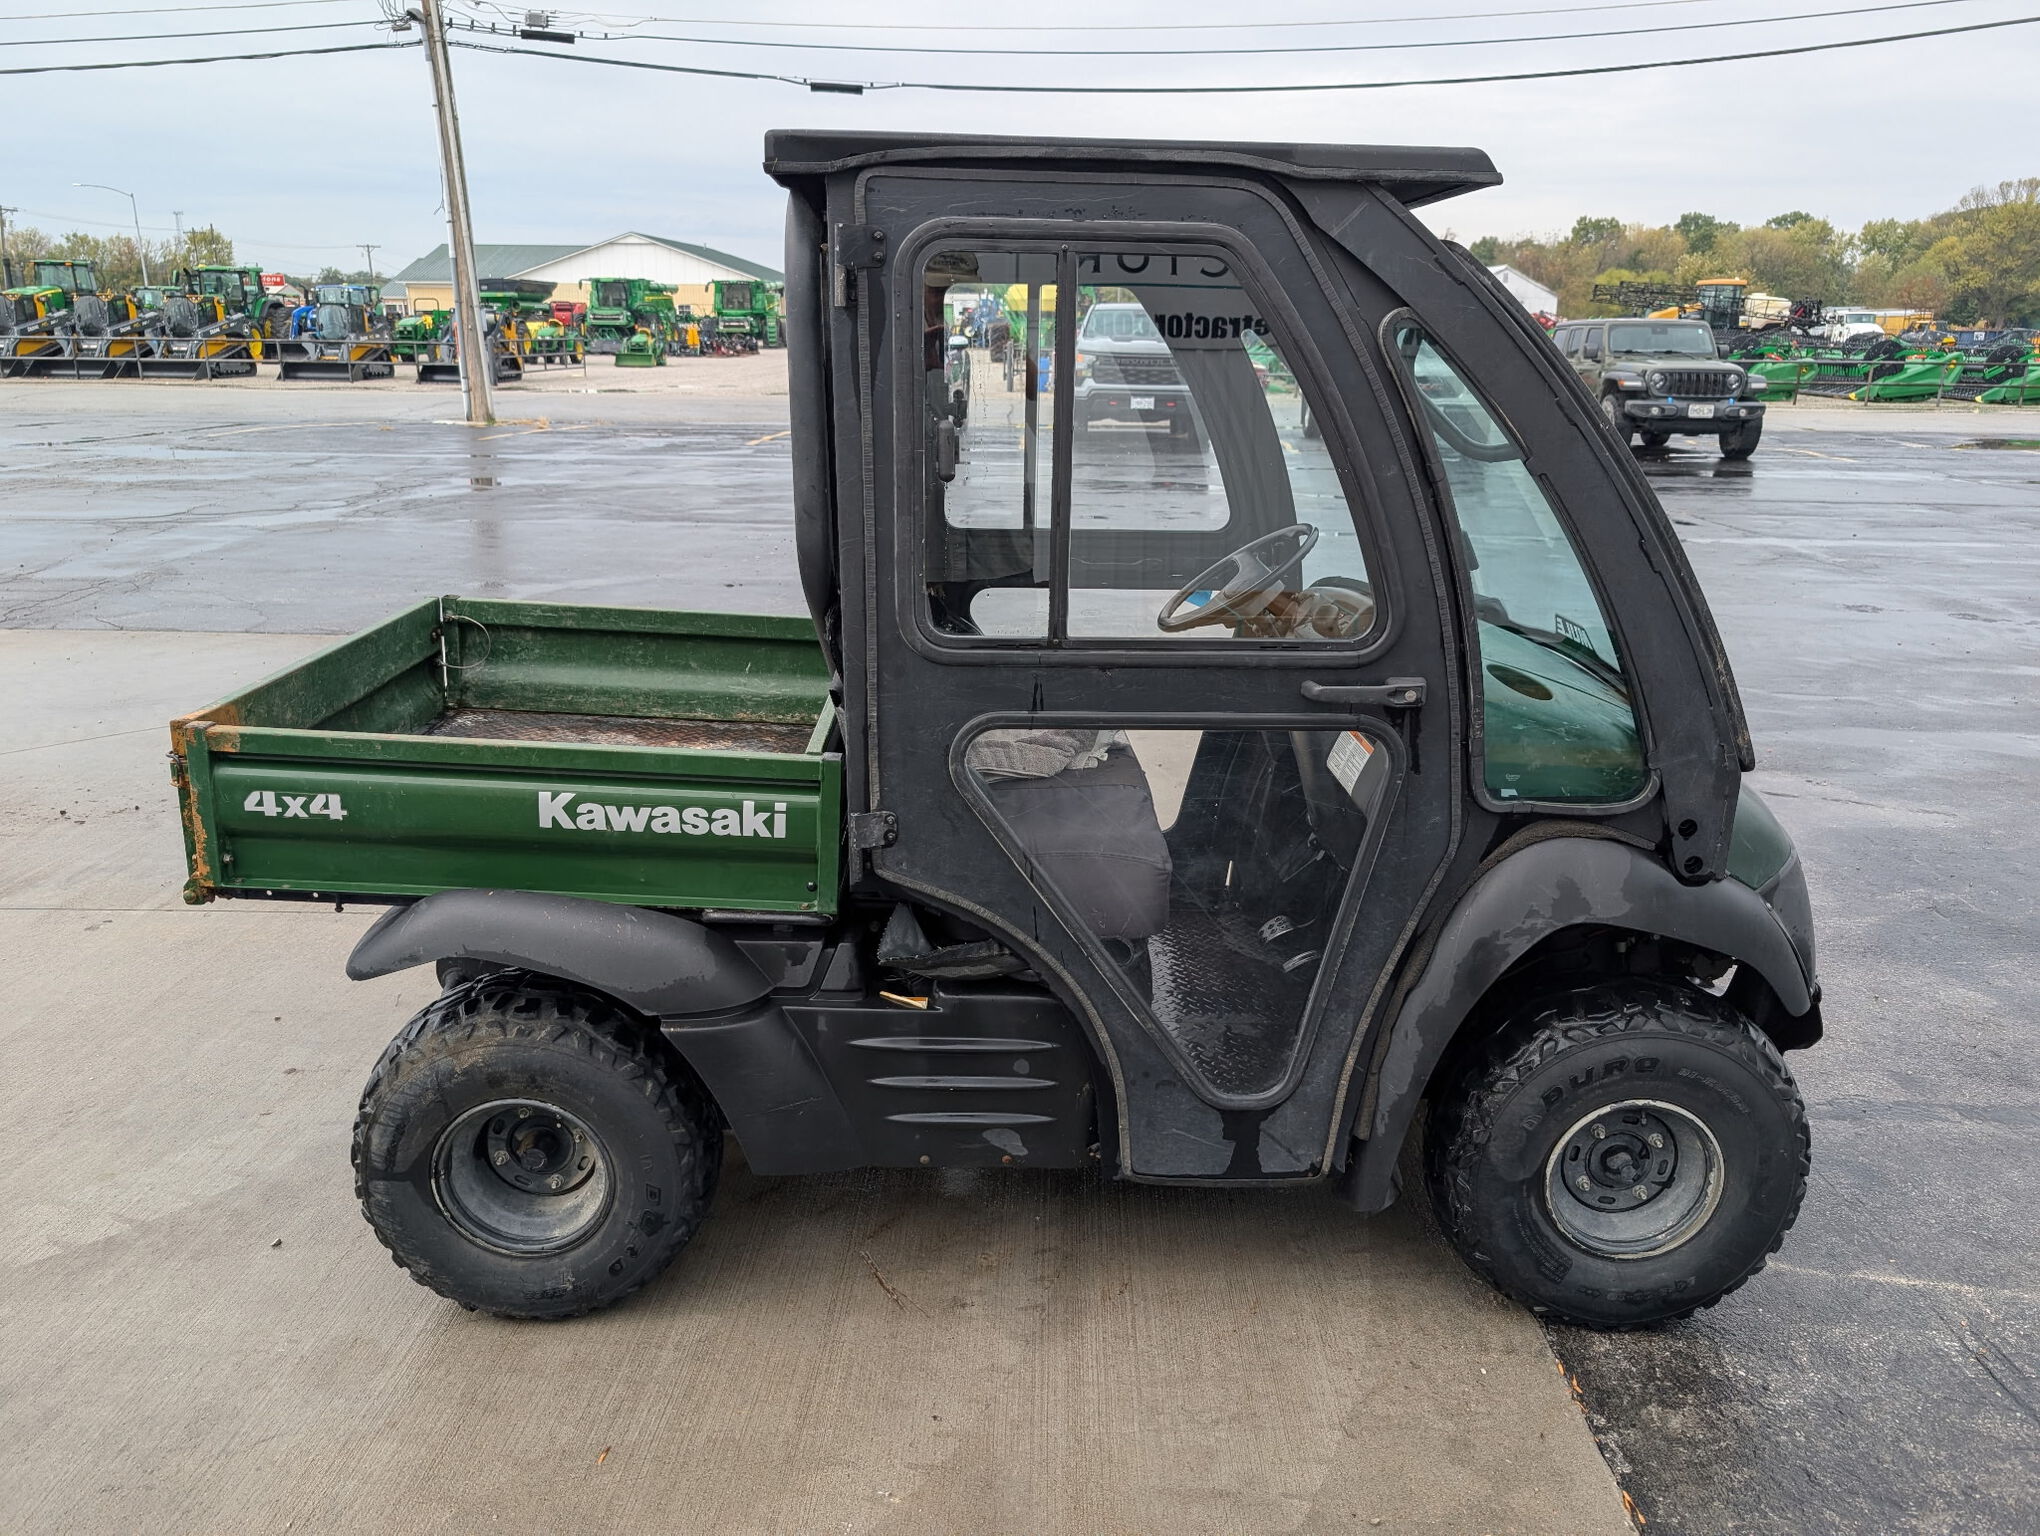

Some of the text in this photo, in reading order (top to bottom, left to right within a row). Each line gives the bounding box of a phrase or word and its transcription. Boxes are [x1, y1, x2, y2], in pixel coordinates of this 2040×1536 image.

[243, 790, 348, 821] 4x4
[538, 791, 787, 839] Kawasaki
[1541, 1056, 1661, 1112] DURO
